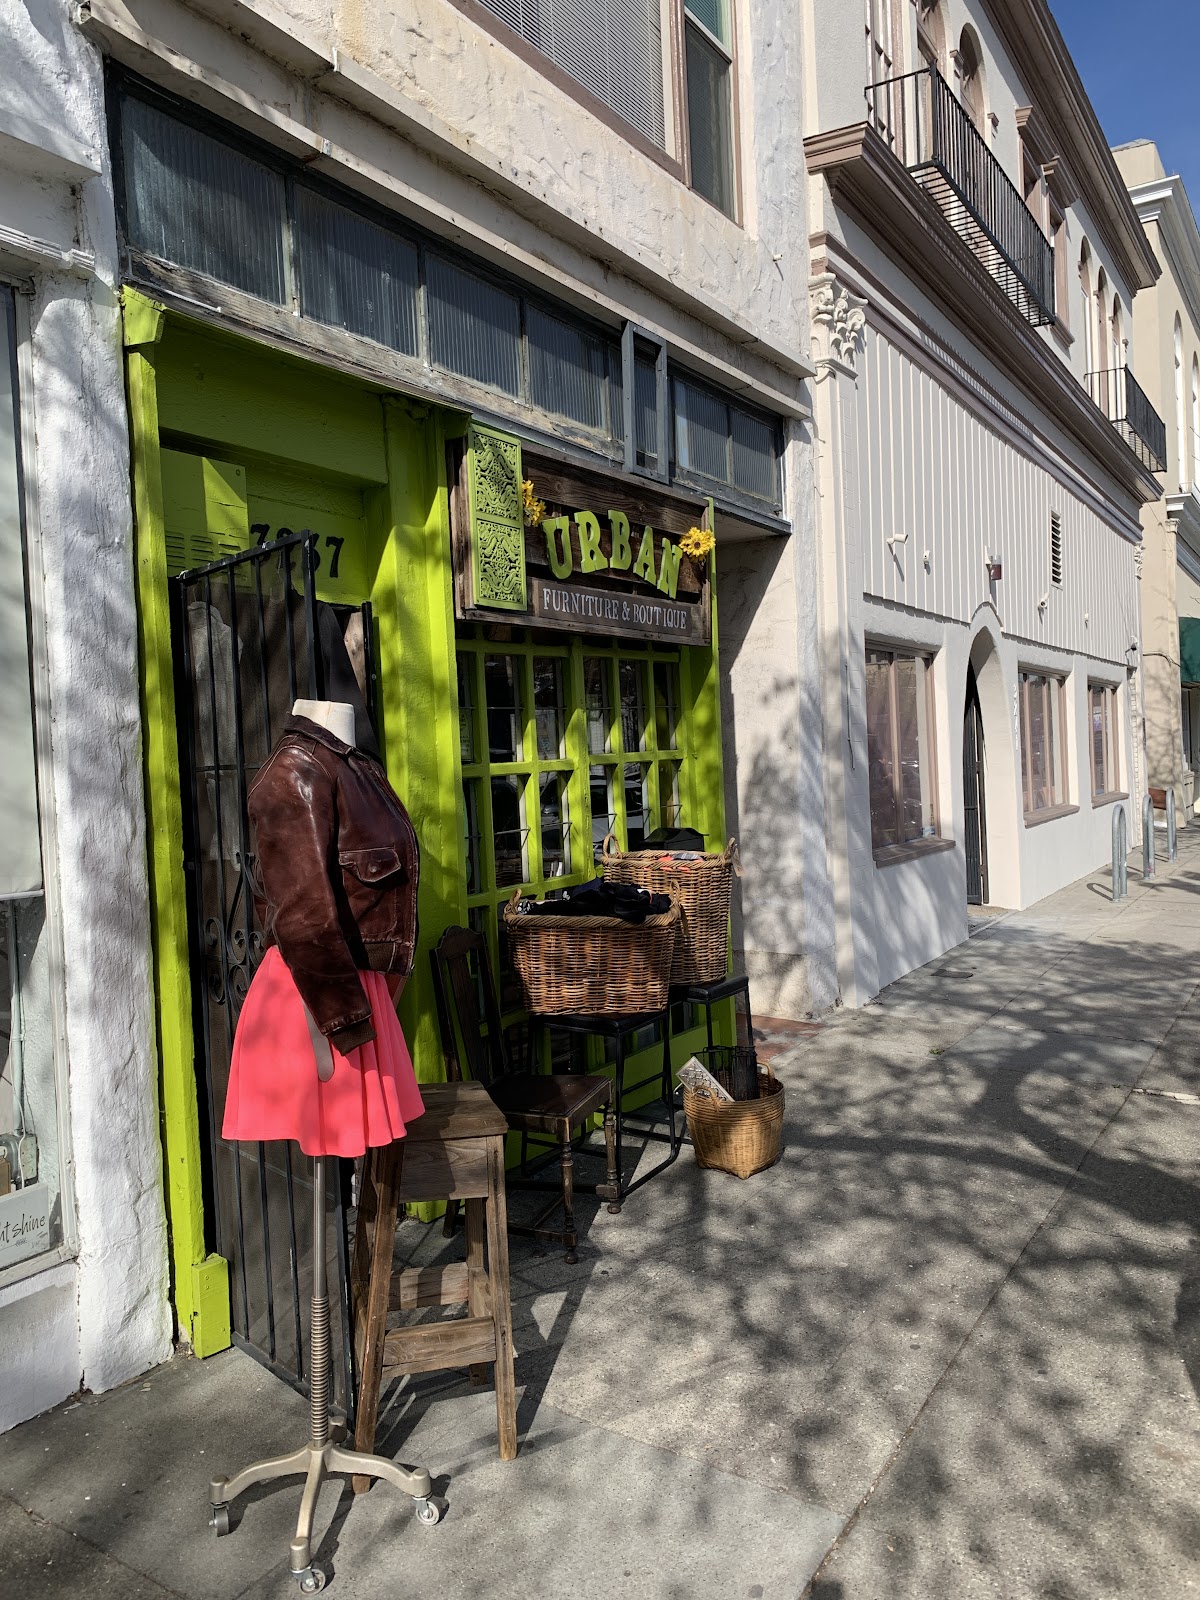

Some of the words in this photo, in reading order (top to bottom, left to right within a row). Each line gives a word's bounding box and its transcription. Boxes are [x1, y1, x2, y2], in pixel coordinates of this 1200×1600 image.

[542, 509, 683, 599] URBAN
[542, 587, 619, 620] FURNITURE
[621, 601, 631, 621] &
[633, 603, 687, 629] BOUTIQUE
